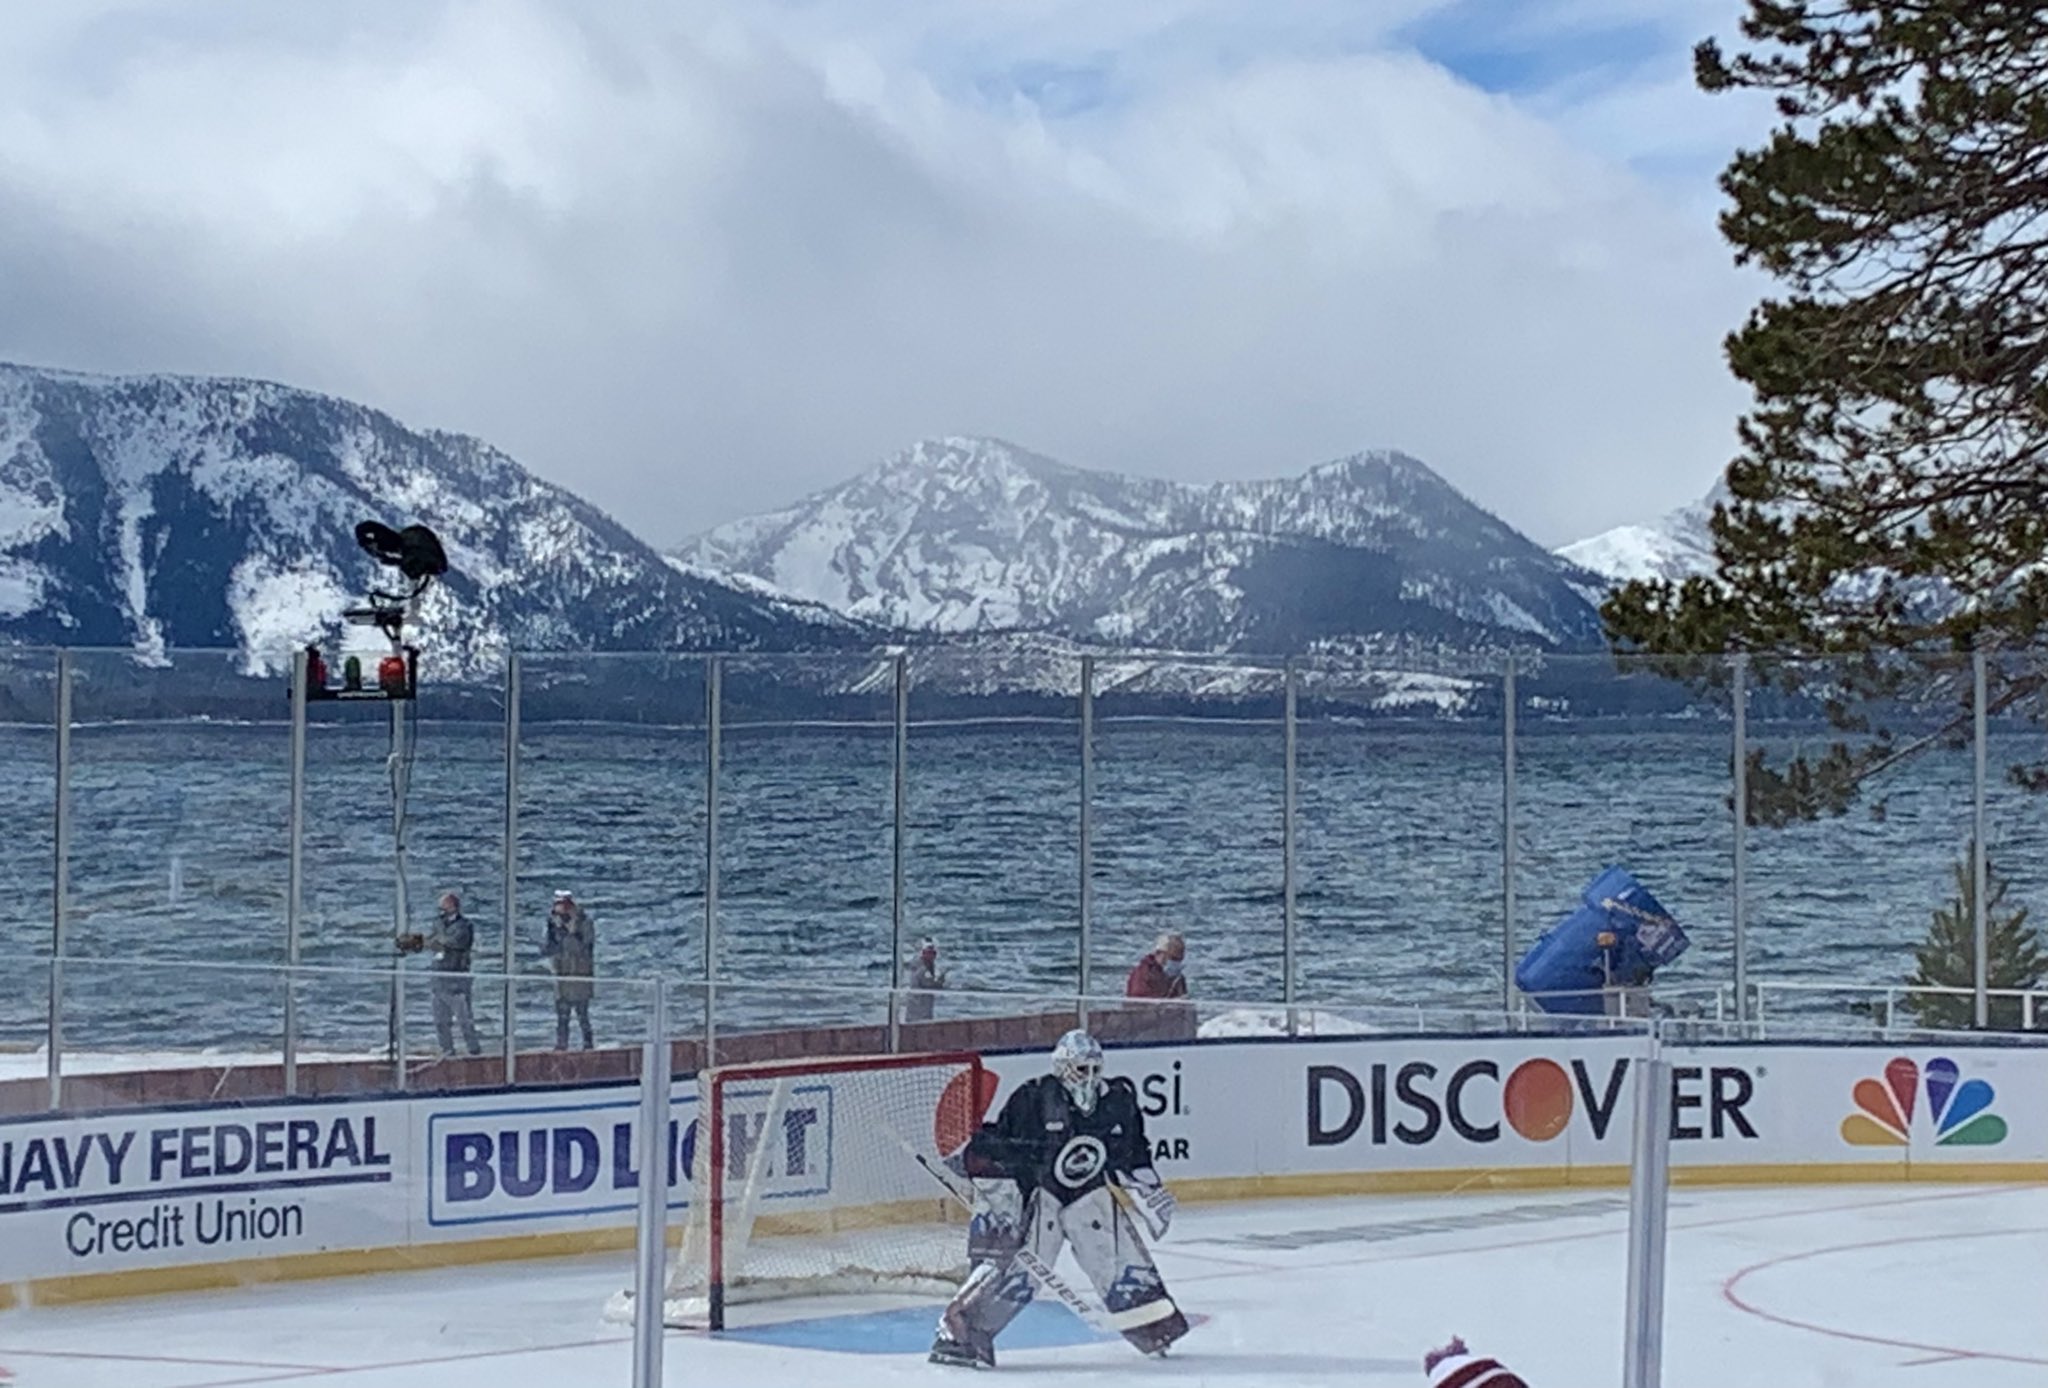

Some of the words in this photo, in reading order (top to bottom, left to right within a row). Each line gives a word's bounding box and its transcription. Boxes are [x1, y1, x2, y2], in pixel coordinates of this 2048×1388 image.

[1307, 1057, 1759, 1145] DISCOVER
[150, 1116, 391, 1181] FEDERAL
[446, 1126, 601, 1203] BUD
[66, 1204, 184, 1257] Credit
[196, 1198, 302, 1244] Union
